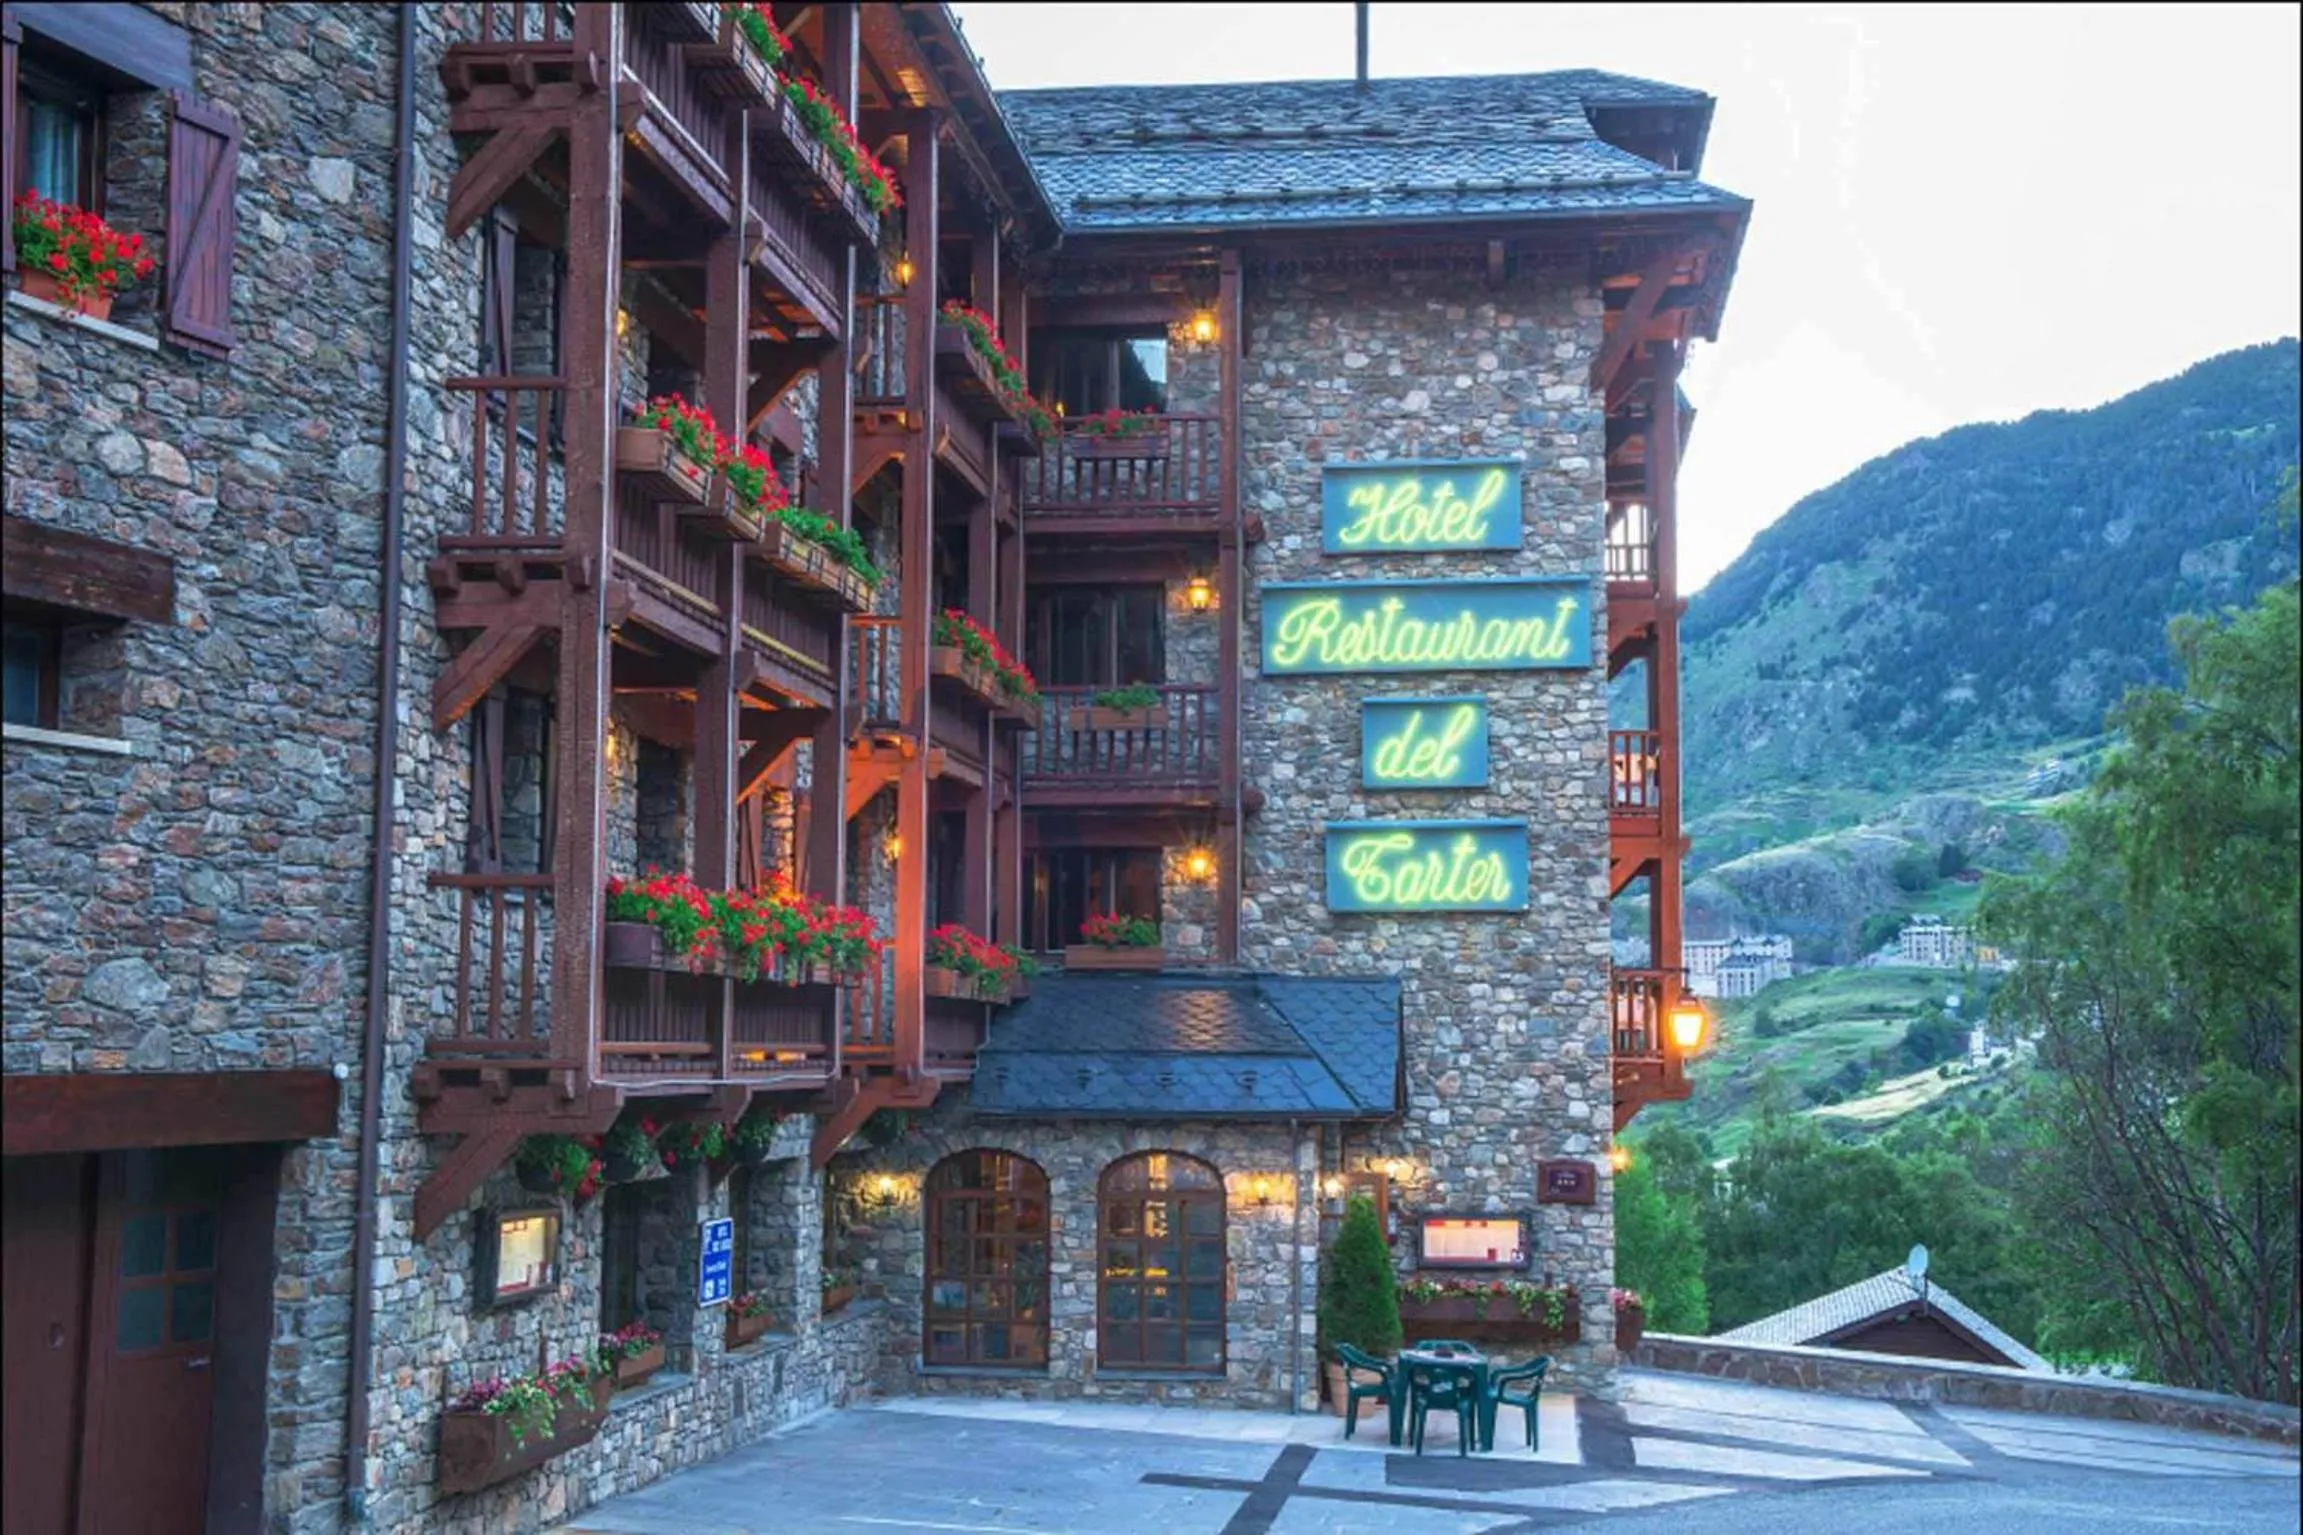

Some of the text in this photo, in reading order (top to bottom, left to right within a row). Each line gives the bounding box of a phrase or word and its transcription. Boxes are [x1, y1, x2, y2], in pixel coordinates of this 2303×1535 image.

[1338, 468, 1506, 545] Hotel
[1272, 595, 1579, 666] Restaurant
[1373, 704, 1475, 779] del
[1341, 833, 1513, 904] Tarter
